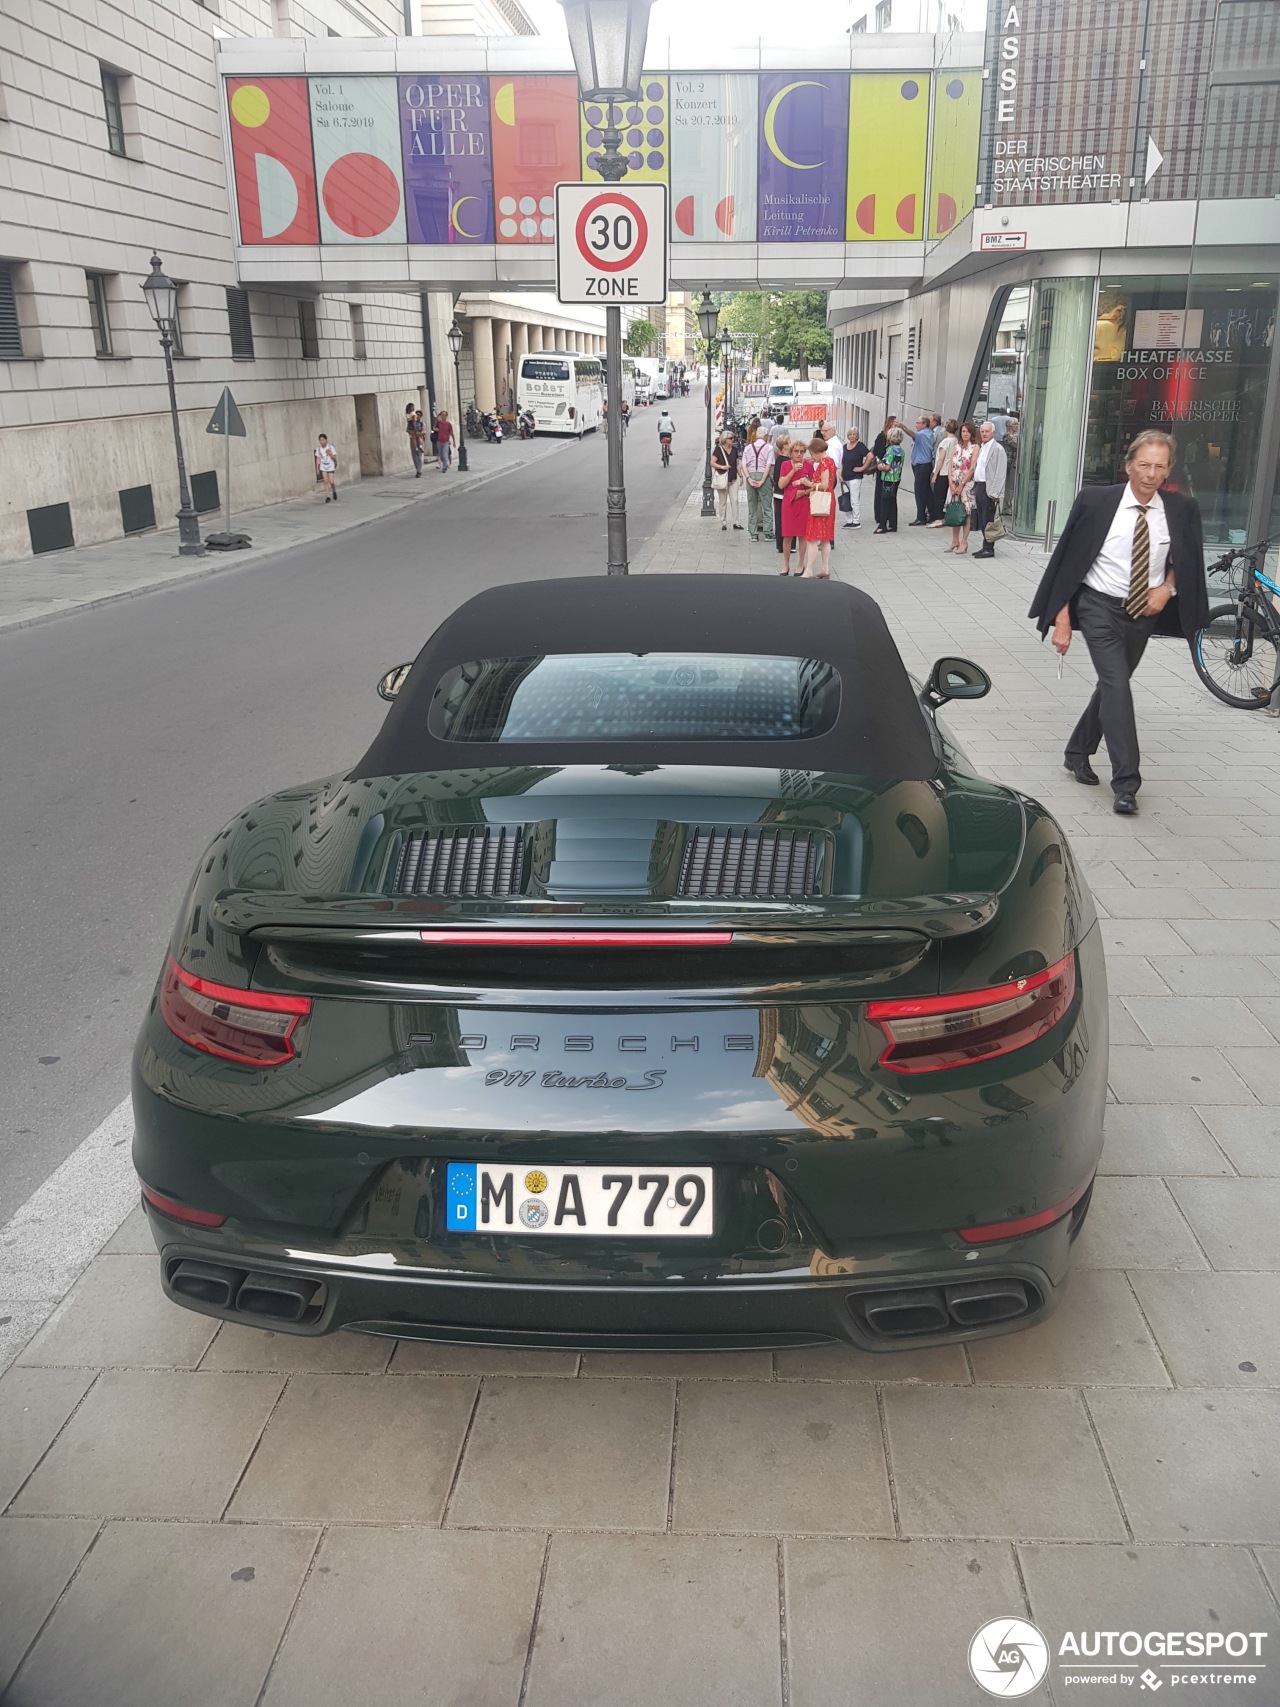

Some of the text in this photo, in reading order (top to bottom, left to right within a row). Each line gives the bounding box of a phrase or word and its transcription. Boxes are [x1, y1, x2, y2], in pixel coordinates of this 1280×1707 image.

[315, 84, 344, 96] Vol. 1
[675, 81, 705, 94] Vol. 2
[405, 84, 483, 108] OPER
[315, 101, 355, 113] Salome
[675, 98, 718, 110] Konzert
[316, 116, 375, 129] Sa 6.7.2019
[408, 108, 469, 132] FÜR
[675, 114, 738, 127] Sa 20.7.2019
[408, 132, 485, 156] ALLE
[996, 140, 1028, 155] DER
[994, 155, 1105, 173] BAYERISCHEN
[993, 174, 1121, 192] STAATSTHEATER
[763, 193, 831, 205] Musikalische
[763, 209, 805, 223] Leitung
[590, 214, 632, 251] 30
[763, 225, 838, 238] Kirill Petrenko
[985, 235, 1002, 244] BMZ
[585, 277, 639, 296] ZONE
[1120, 351, 1233, 363] THEATERKASSE
[1116, 367, 1208, 380] BOX OFFICE
[1151, 400, 1241, 411] BAYERISCHE
[1149, 411, 1240, 422] STAATSOPER
[406, 1032, 755, 1051] PORSCHE
[485, 1069, 667, 1090] 911 turbo S
[481, 1171, 706, 1227] M A 779
[456, 1204, 468, 1219] D
